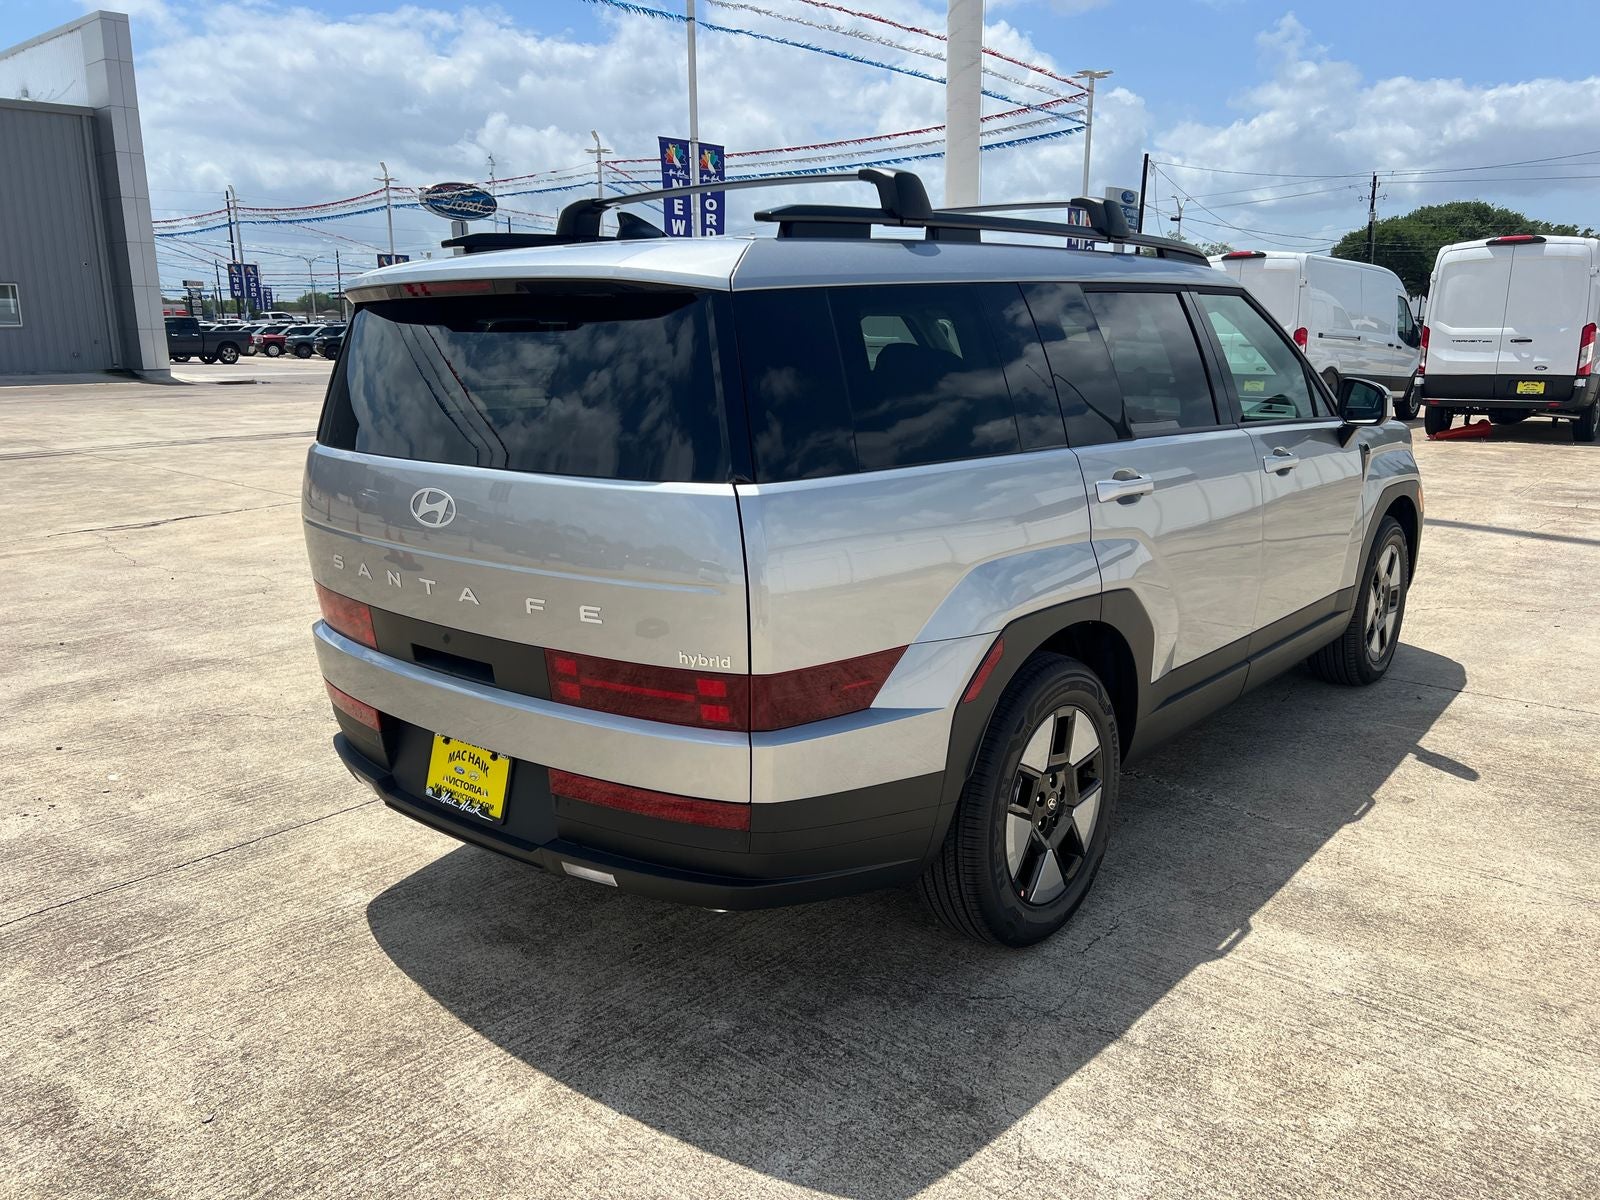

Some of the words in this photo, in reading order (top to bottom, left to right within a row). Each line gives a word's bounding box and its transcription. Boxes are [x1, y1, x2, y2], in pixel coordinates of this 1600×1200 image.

[705, 191, 717, 236] ORD
[233, 277, 241, 297] NEW
[332, 553, 481, 607] SANTA
[525, 597, 603, 625] FE
[679, 651, 731, 669] hybrid
[448, 750, 467, 763] MAC
[468, 751, 489, 777] HAIK
[448, 775, 483, 797] VICTORIA
[438, 791, 459, 807] Mac
[459, 800, 484, 815] Haik
